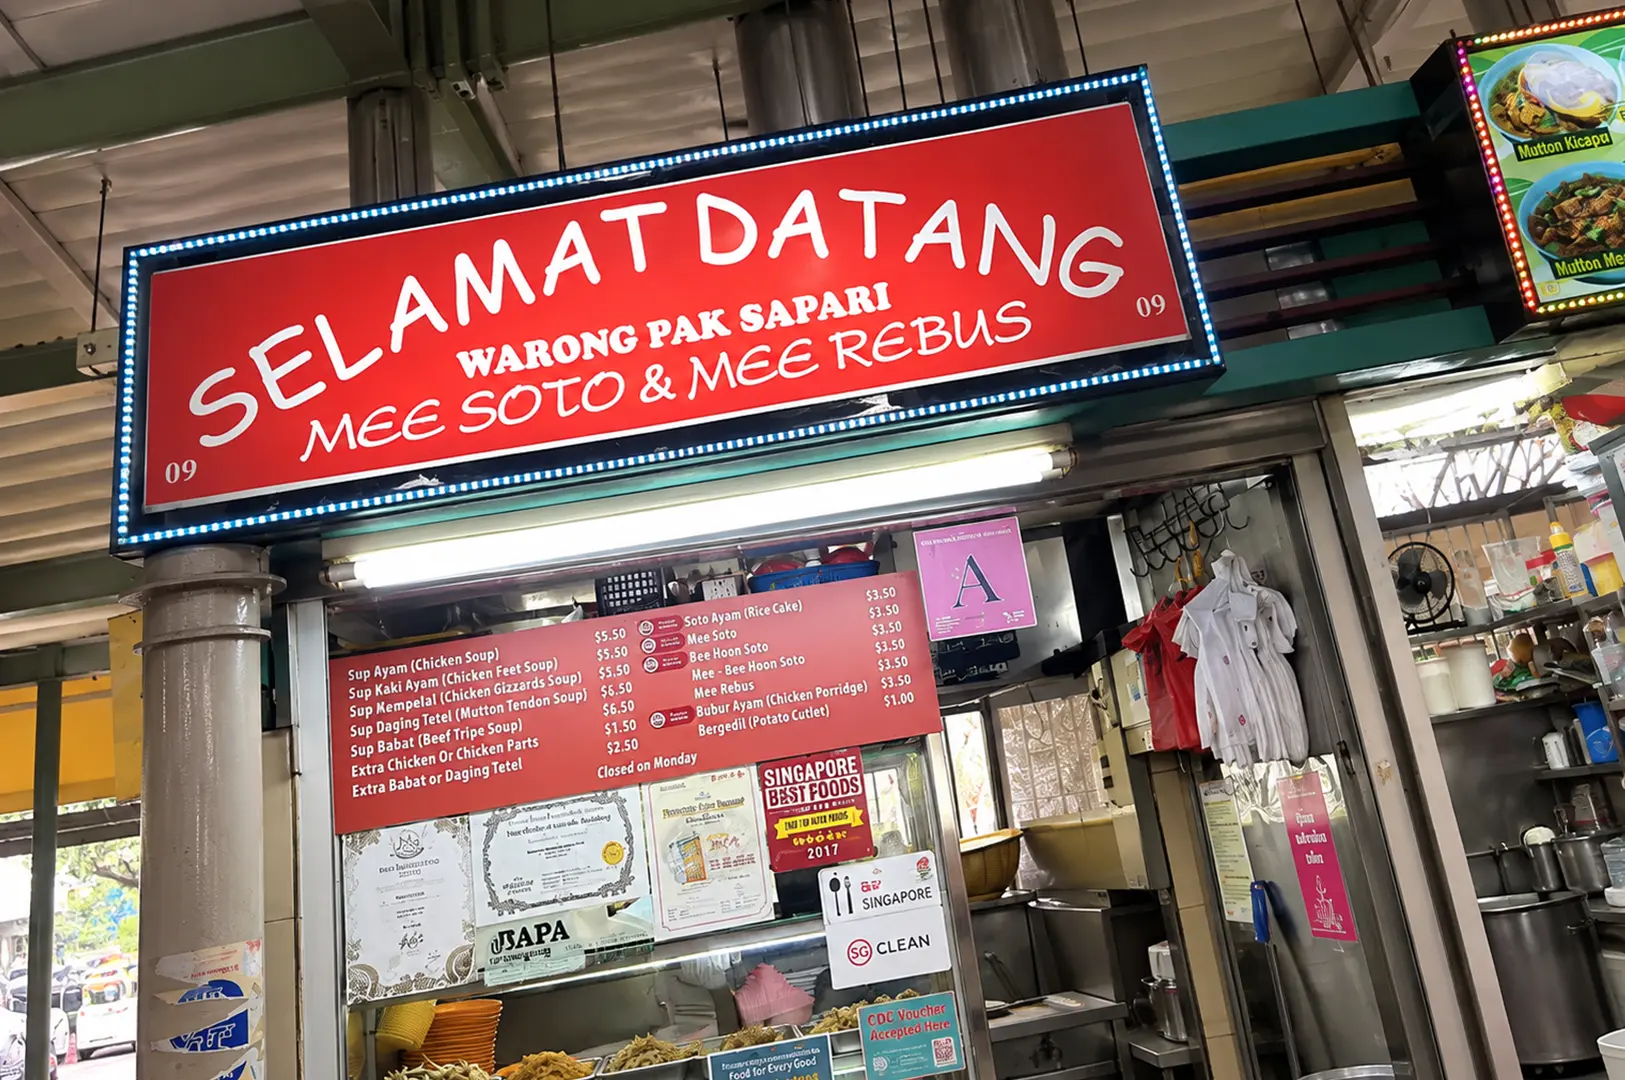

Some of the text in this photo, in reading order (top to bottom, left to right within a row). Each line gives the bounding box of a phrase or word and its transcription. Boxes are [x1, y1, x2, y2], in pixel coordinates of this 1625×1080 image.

[1518, 141, 1563, 159] Mutton
[1555, 252, 1625, 276] Mutton Me
[189, 188, 1124, 447] SELAMAT DATANG
[1137, 295, 1165, 317] 09
[456, 282, 892, 378] WARONG PAK SAPARI
[300, 301, 1031, 462] MEE SOTO & MEE REBUS
[166, 460, 196, 483] 09
[952, 555, 1003, 608] A
[866, 586, 896, 602] $3.50
[683, 615, 709, 628] Soto
[711, 611, 742, 626] Ayam
[744, 605, 771, 620] (Rice
[772, 599, 803, 614] Cake)
[869, 603, 900, 619] $3.50
[594, 627, 626, 644] $5.50
[687, 632, 710, 645] Mee
[712, 629, 737, 641] Soto
[871, 620, 902, 637] $3.50
[596, 645, 628, 662] $5.50
[689, 651, 711, 663] Bee
[712, 647, 742, 659] Hoon
[743, 642, 769, 655] Soto
[875, 638, 905, 655] $3.50
[348, 647, 499, 682] Sup Ayam (Chicken Soup)
[598, 663, 630, 680] $5.50
[691, 668, 715, 681] Mee
[724, 664, 746, 676] Bee
[748, 660, 777, 672] Hoon
[779, 655, 806, 668] Soto
[877, 655, 908, 672] $3.50
[348, 656, 558, 701] Sup Kaki Ayam (Chicken Feet Soup)
[600, 681, 633, 699] $6.50
[694, 680, 755, 699] Mee Rebus
[881, 674, 912, 690] $3.50
[349, 704, 373, 719] Sup
[440, 687, 491, 705] (Chicken
[493, 676, 546, 695] Gizzards
[547, 671, 582, 687] Soup)
[696, 703, 730, 718] Bubur
[733, 699, 764, 713] Ayam
[766, 690, 813, 708] (Chicken
[815, 679, 868, 698] Porridge)
[883, 691, 914, 708] $1.00
[350, 687, 587, 739] Sup Daging Tetel (Mutton Tendon Soup)
[602, 699, 635, 717] $6.50
[604, 719, 637, 736] $1.50
[698, 717, 747, 737] Bergedil
[748, 713, 790, 730] (Potato
[791, 703, 830, 721] Cutlet)
[350, 717, 523, 758] Sup Babat (Beef Tripe Soup)
[607, 738, 639, 755] $2.50
[351, 737, 539, 778] Extra Chicken Or Chicken Parts
[597, 751, 697, 779] Closed on Monday
[352, 757, 523, 798] Extra Babat or Daging Tetel
[764, 756, 858, 787] SINGAPORE
[768, 785, 806, 808] BEST
[809, 776, 860, 801] FOODS
[807, 843, 839, 859] 2017
[862, 886, 933, 910] SINGAPORE
[851, 934, 930, 960] SG CLEAN
[867, 1004, 946, 1027] CDC Voucher
[870, 1021, 950, 1041] Accepted Here
[729, 1070, 751, 1080] Food
[752, 1067, 766, 1076] for
[793, 1056, 817, 1069] Good
